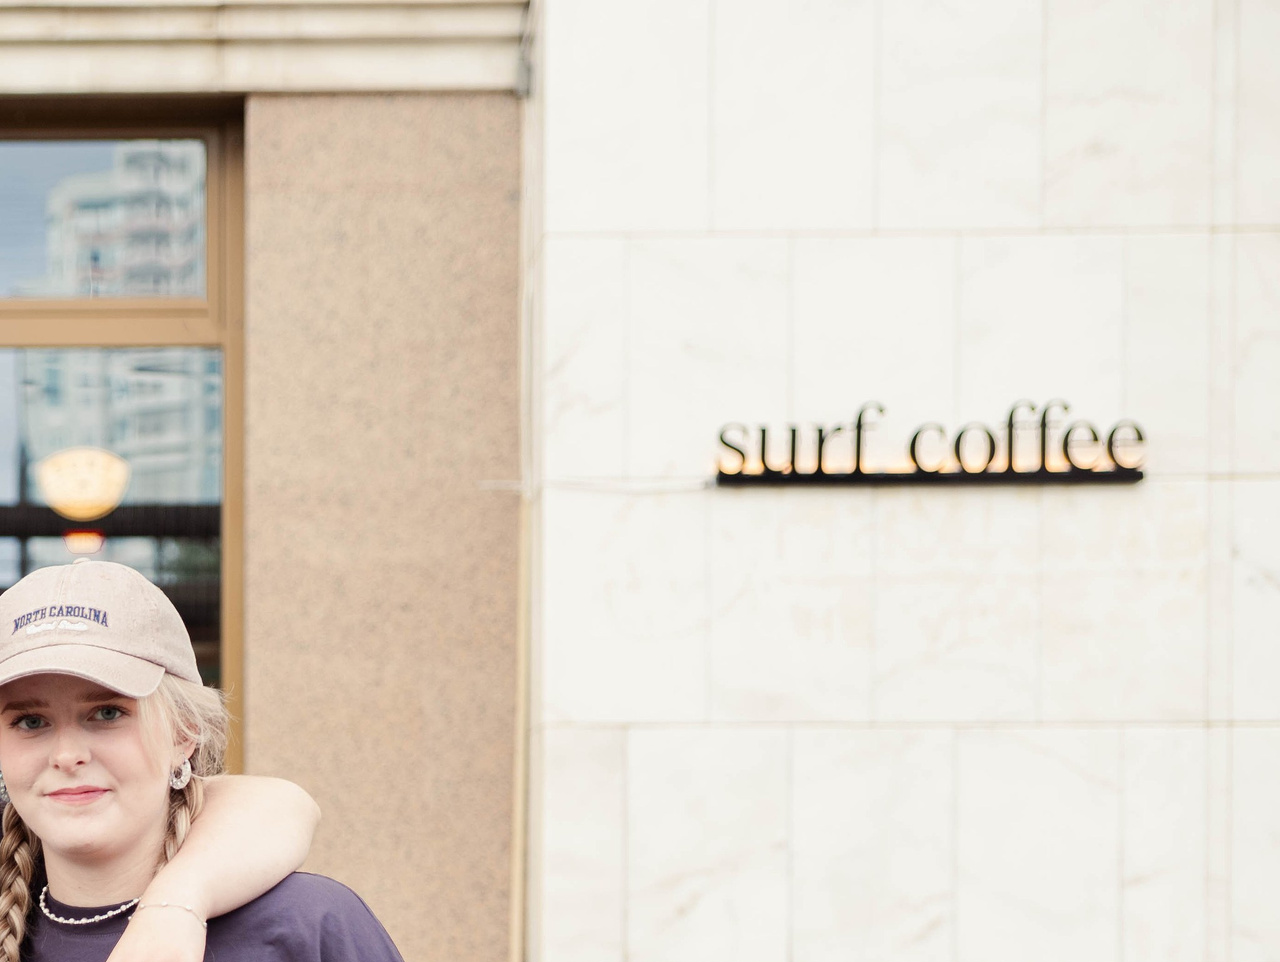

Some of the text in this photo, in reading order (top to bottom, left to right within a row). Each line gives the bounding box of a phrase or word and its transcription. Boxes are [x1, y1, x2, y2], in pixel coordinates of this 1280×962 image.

[718, 399, 1145, 475] surf coffee
[11, 606, 47, 635] NORTH
[48, 605, 109, 628] CAROLINA
